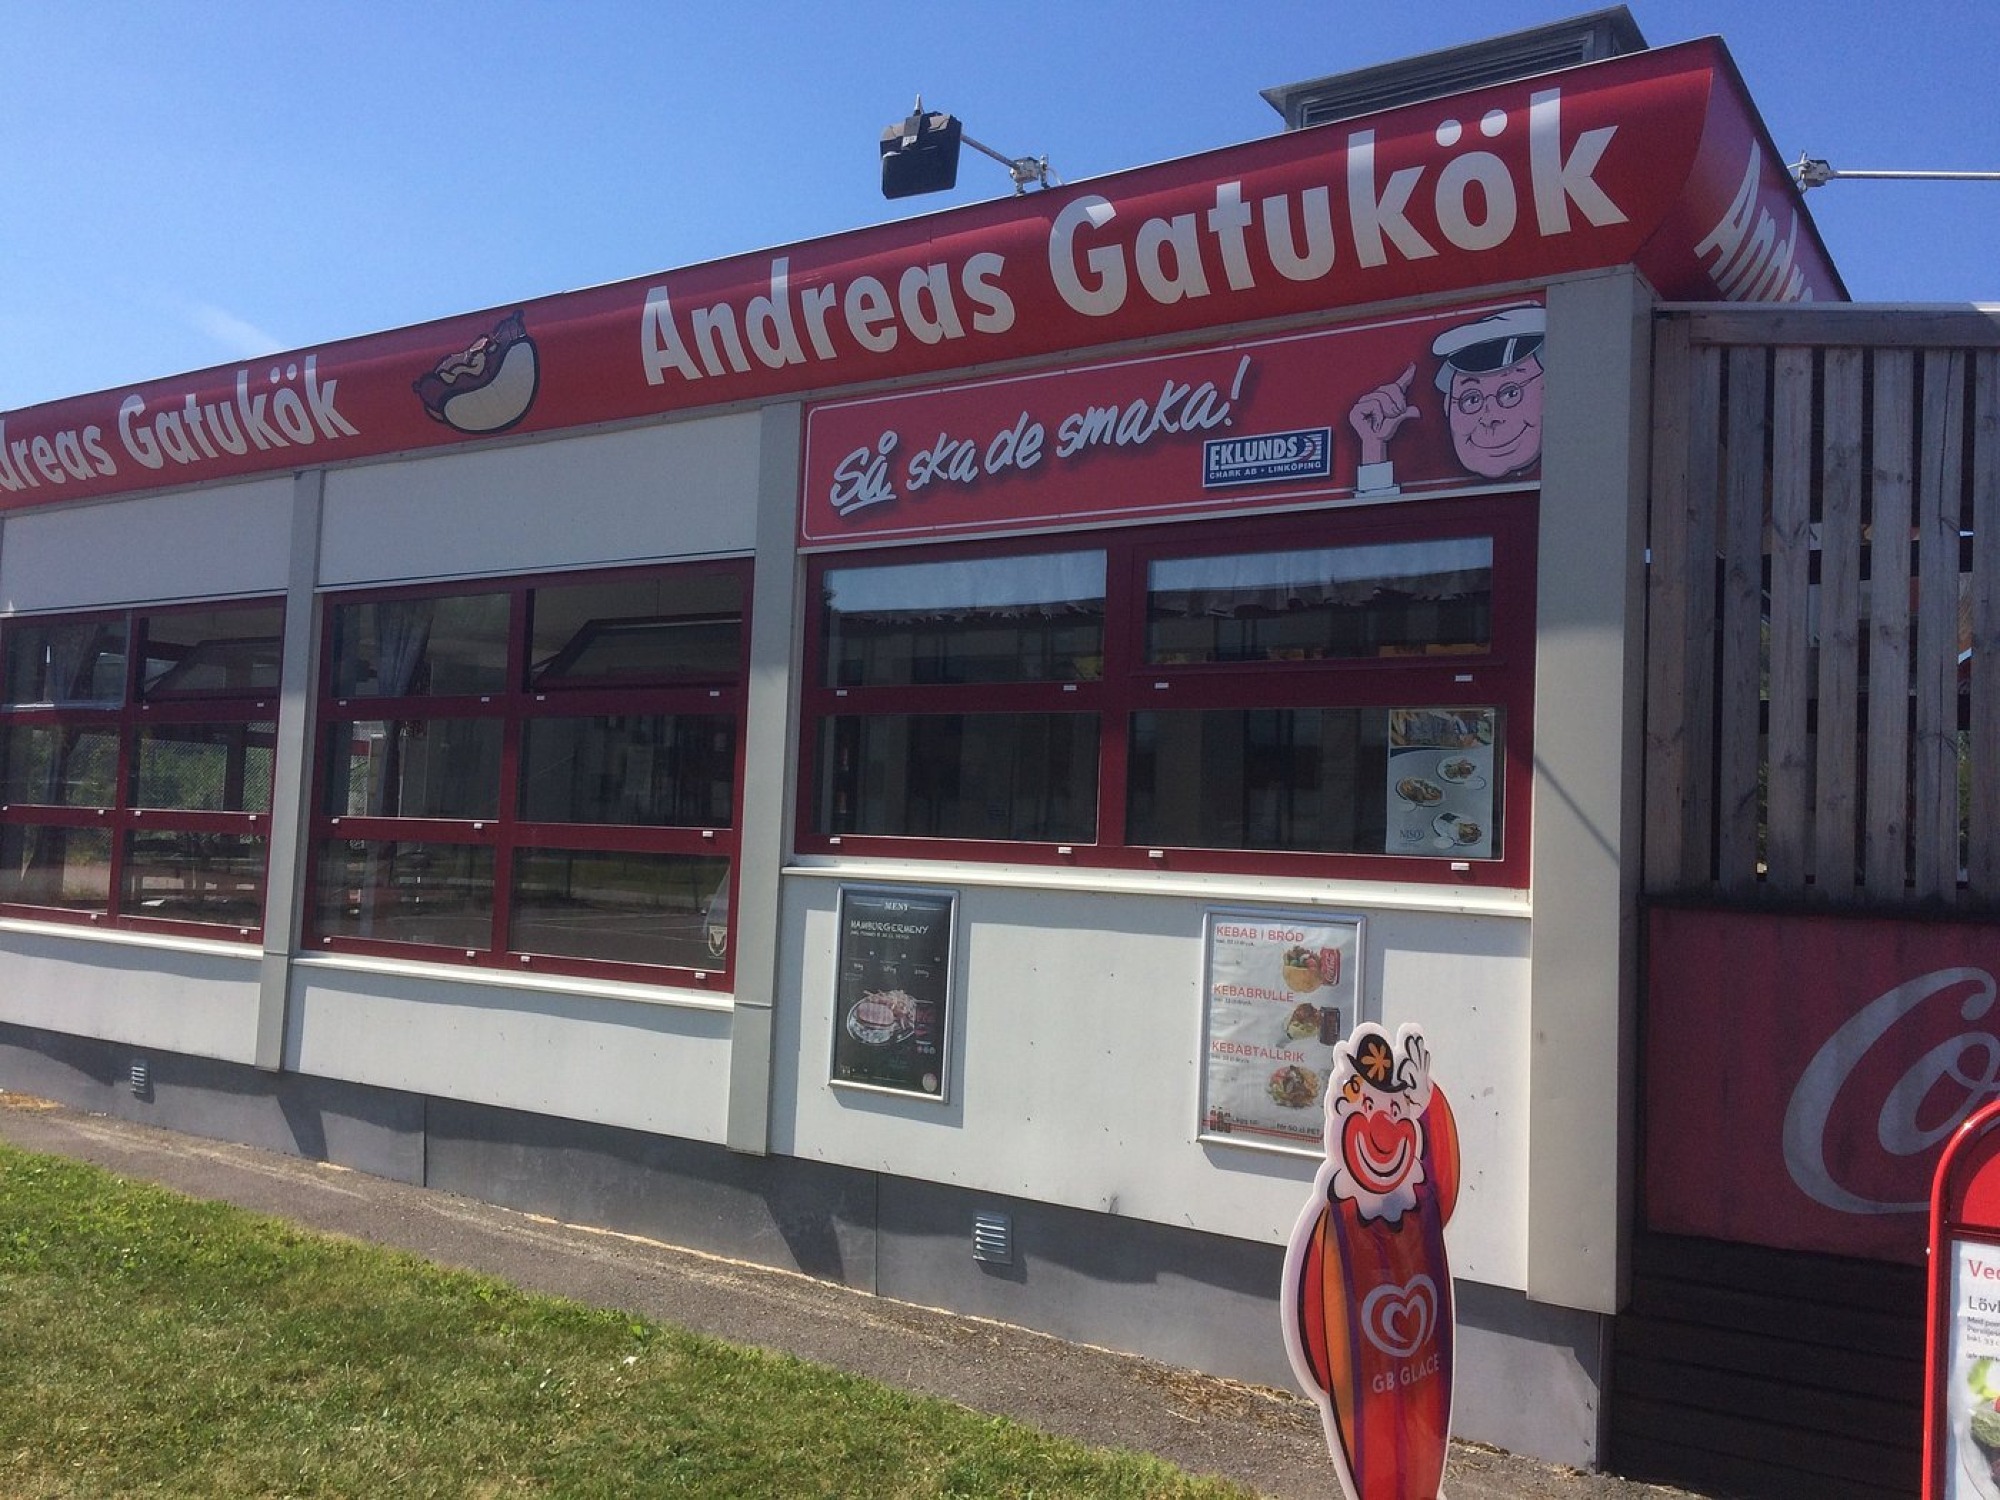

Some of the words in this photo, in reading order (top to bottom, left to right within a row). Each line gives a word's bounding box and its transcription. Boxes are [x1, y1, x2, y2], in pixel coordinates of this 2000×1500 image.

[641, 257, 1016, 387] Andreas
[1048, 87, 1630, 317] Gatukök
[0, 420, 118, 492] dreas
[118, 354, 361, 470] Gatukök
[829, 429, 898, 514] Så
[905, 431, 979, 492] ska
[985, 411, 1044, 476] de
[1056, 355, 1252, 459] smaka!
[1209, 436, 1299, 471] EKLUNDS
[1209, 469, 1241, 480] CHARK
[1244, 467, 1258, 476] AB
[1268, 461, 1322, 474] LINKÖPING
[850, 919, 930, 935] HAMBURGERMENY
[1216, 926, 1258, 940] KEBAB
[1268, 928, 1305, 942] BRÖD
[1213, 985, 1294, 1003] KEBABRULLE
[1211, 1040, 1305, 1063] KEBABTALLRIK
[1969, 1295, 2000, 1314] Löv
[1372, 1372, 1395, 1394] GB
[1400, 1353, 1440, 1386] GLACE
